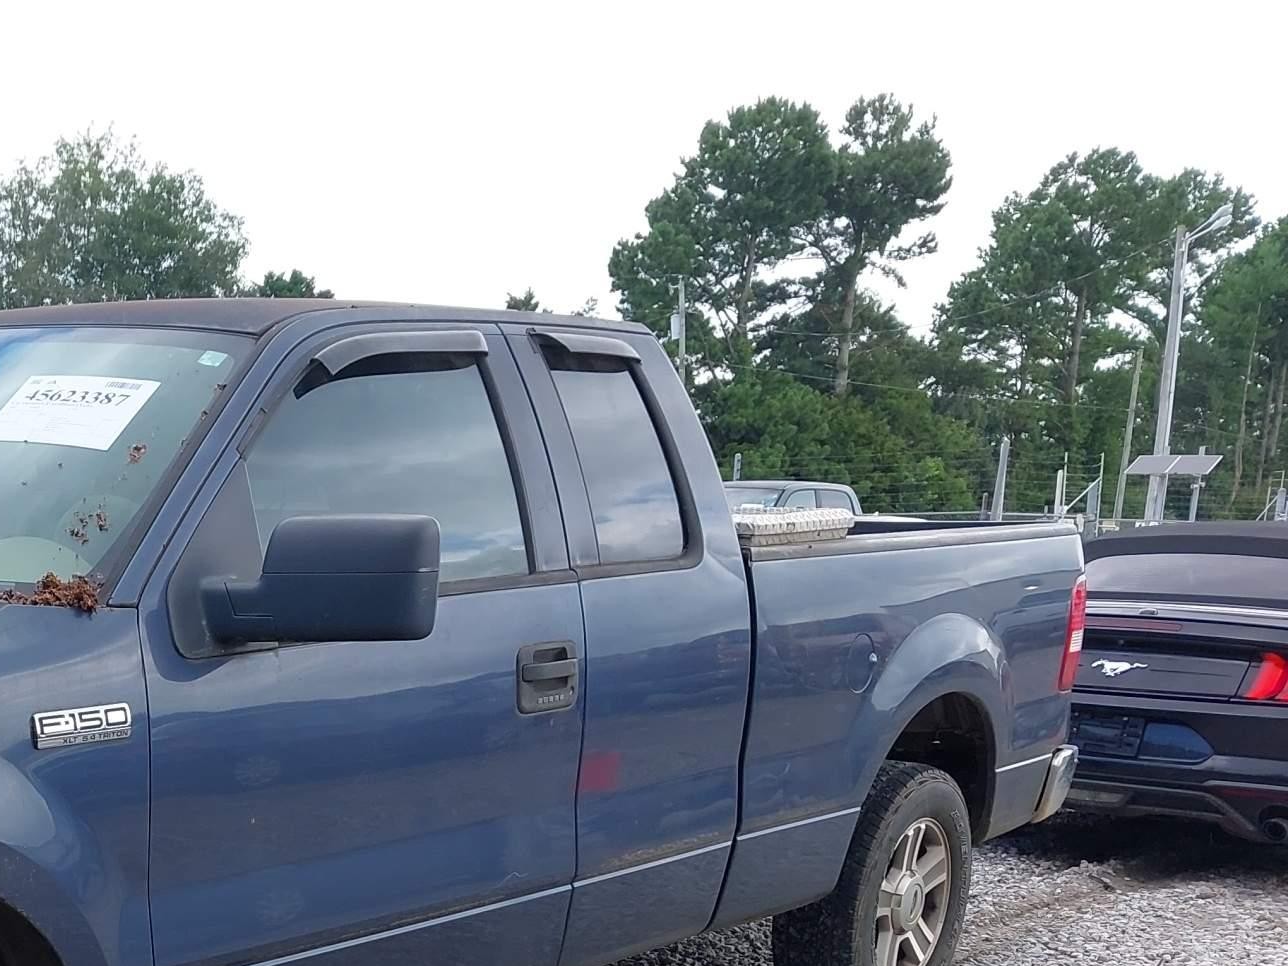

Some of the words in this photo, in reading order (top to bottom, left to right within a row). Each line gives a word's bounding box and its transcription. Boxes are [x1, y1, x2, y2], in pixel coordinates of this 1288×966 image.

[25, 389, 131, 406] 45623387
[38, 707, 127, 734] F-150
[62, 736, 78, 745] XLT
[98, 729, 129, 740] TRITON
